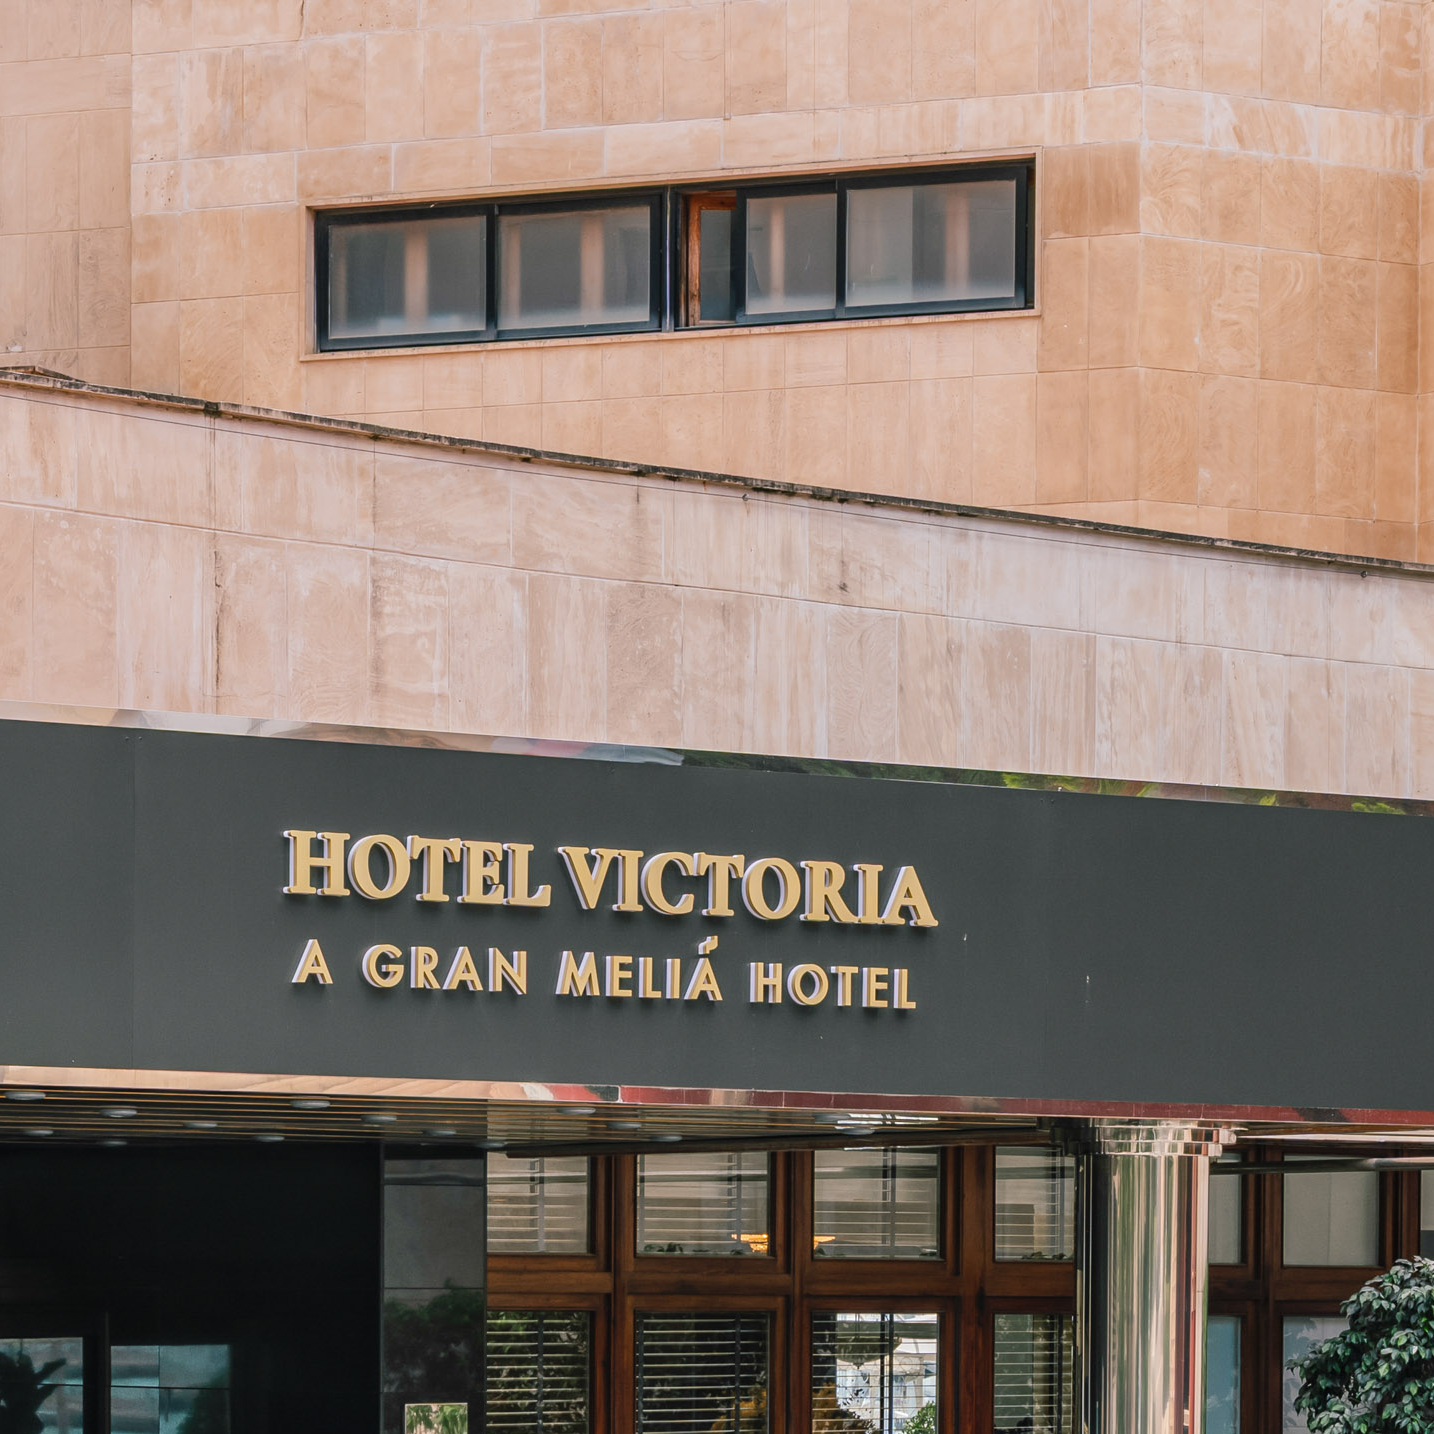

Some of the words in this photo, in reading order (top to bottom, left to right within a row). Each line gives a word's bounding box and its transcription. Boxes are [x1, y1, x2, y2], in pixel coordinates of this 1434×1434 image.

[282, 829, 552, 908] HOTEL
[557, 845, 939, 928] VICTORIA
[291, 938, 334, 985] A
[362, 943, 528, 996] GRAN
[555, 935, 723, 1003] MELIÁ
[749, 961, 917, 1010] HOTEL
